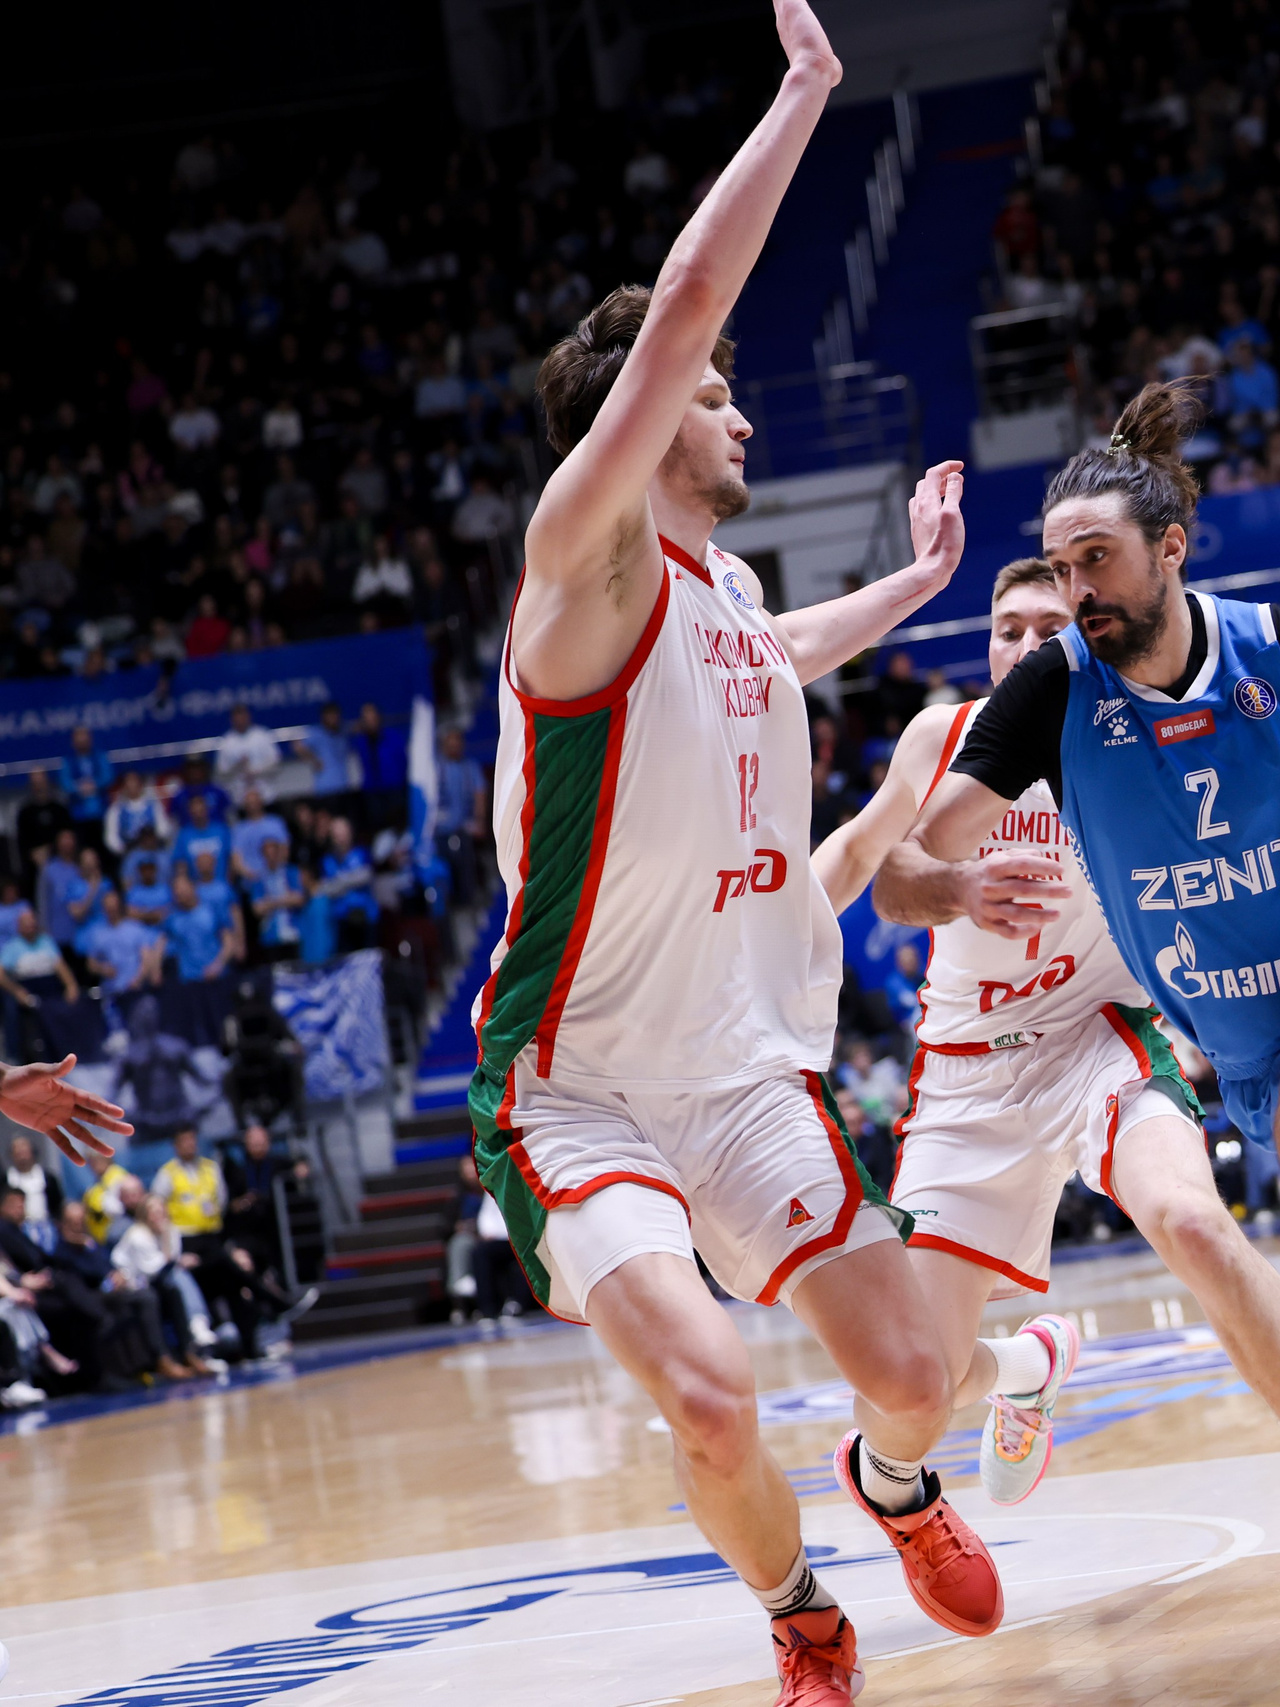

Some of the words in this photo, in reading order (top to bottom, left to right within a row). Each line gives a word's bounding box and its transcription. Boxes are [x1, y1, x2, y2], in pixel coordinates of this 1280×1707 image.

[1103, 735, 1139, 748] KELME
[1160, 725, 1174, 739] 80
[1174, 717, 1208, 735] ПОБЕДА!
[738, 751, 760, 833] 12
[1184, 766, 1231, 841] 2
